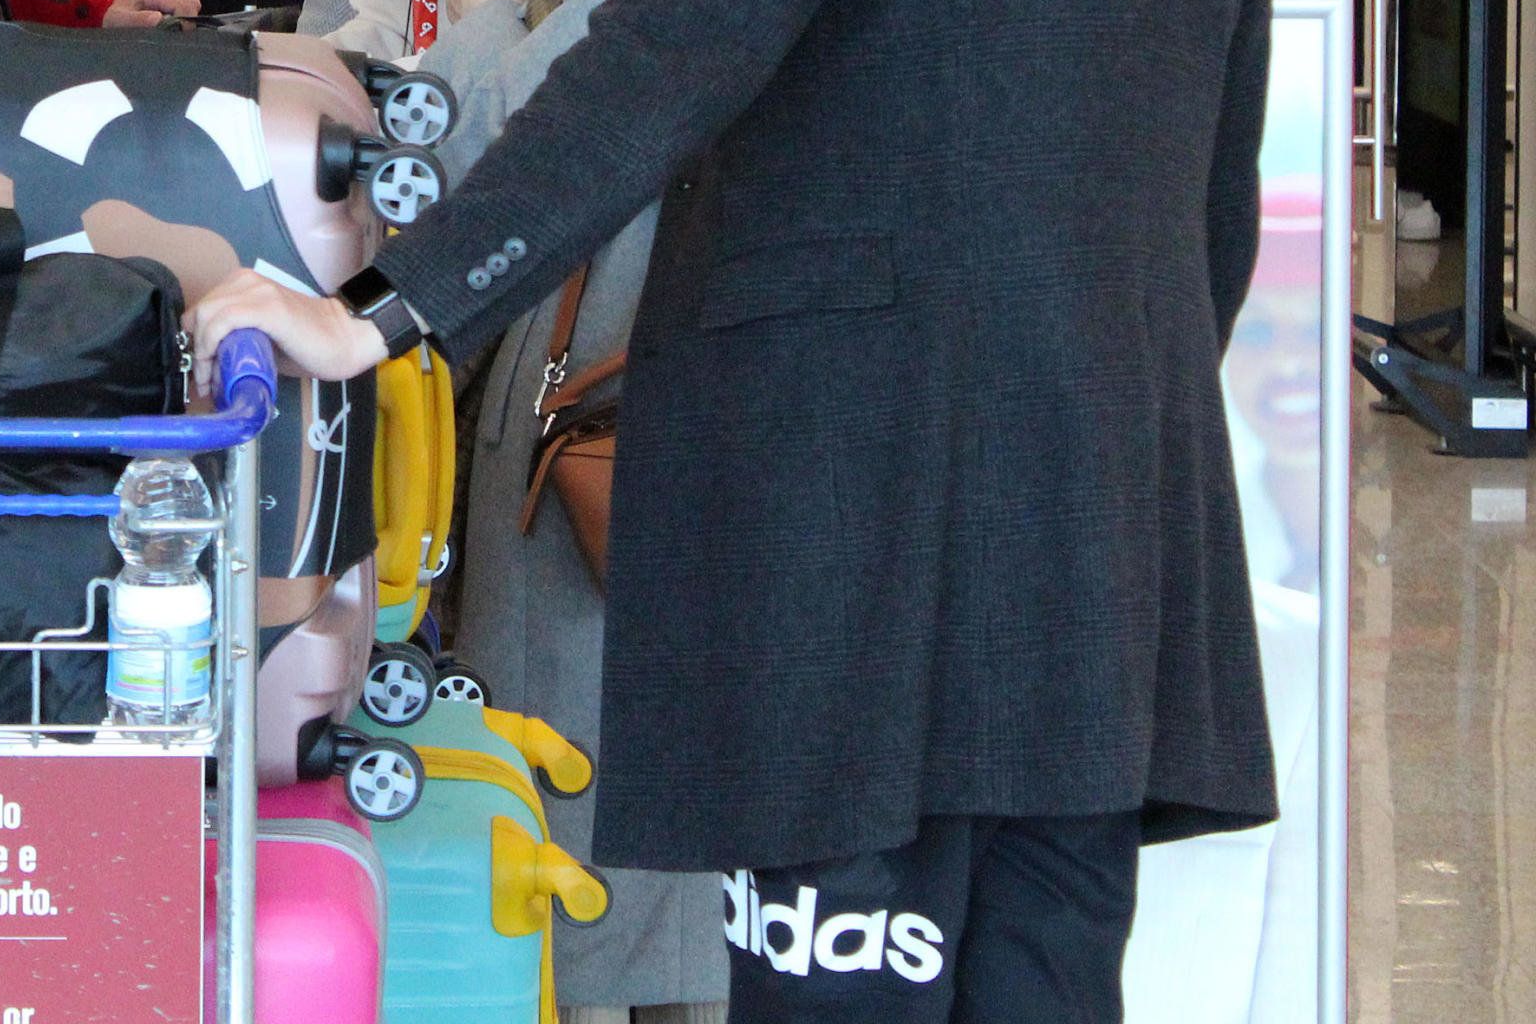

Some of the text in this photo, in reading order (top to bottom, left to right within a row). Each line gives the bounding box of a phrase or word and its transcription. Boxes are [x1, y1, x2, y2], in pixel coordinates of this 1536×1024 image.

[18, 844, 37, 873] e
[722, 869, 944, 983] didas
[3, 1006, 35, 1024] or
